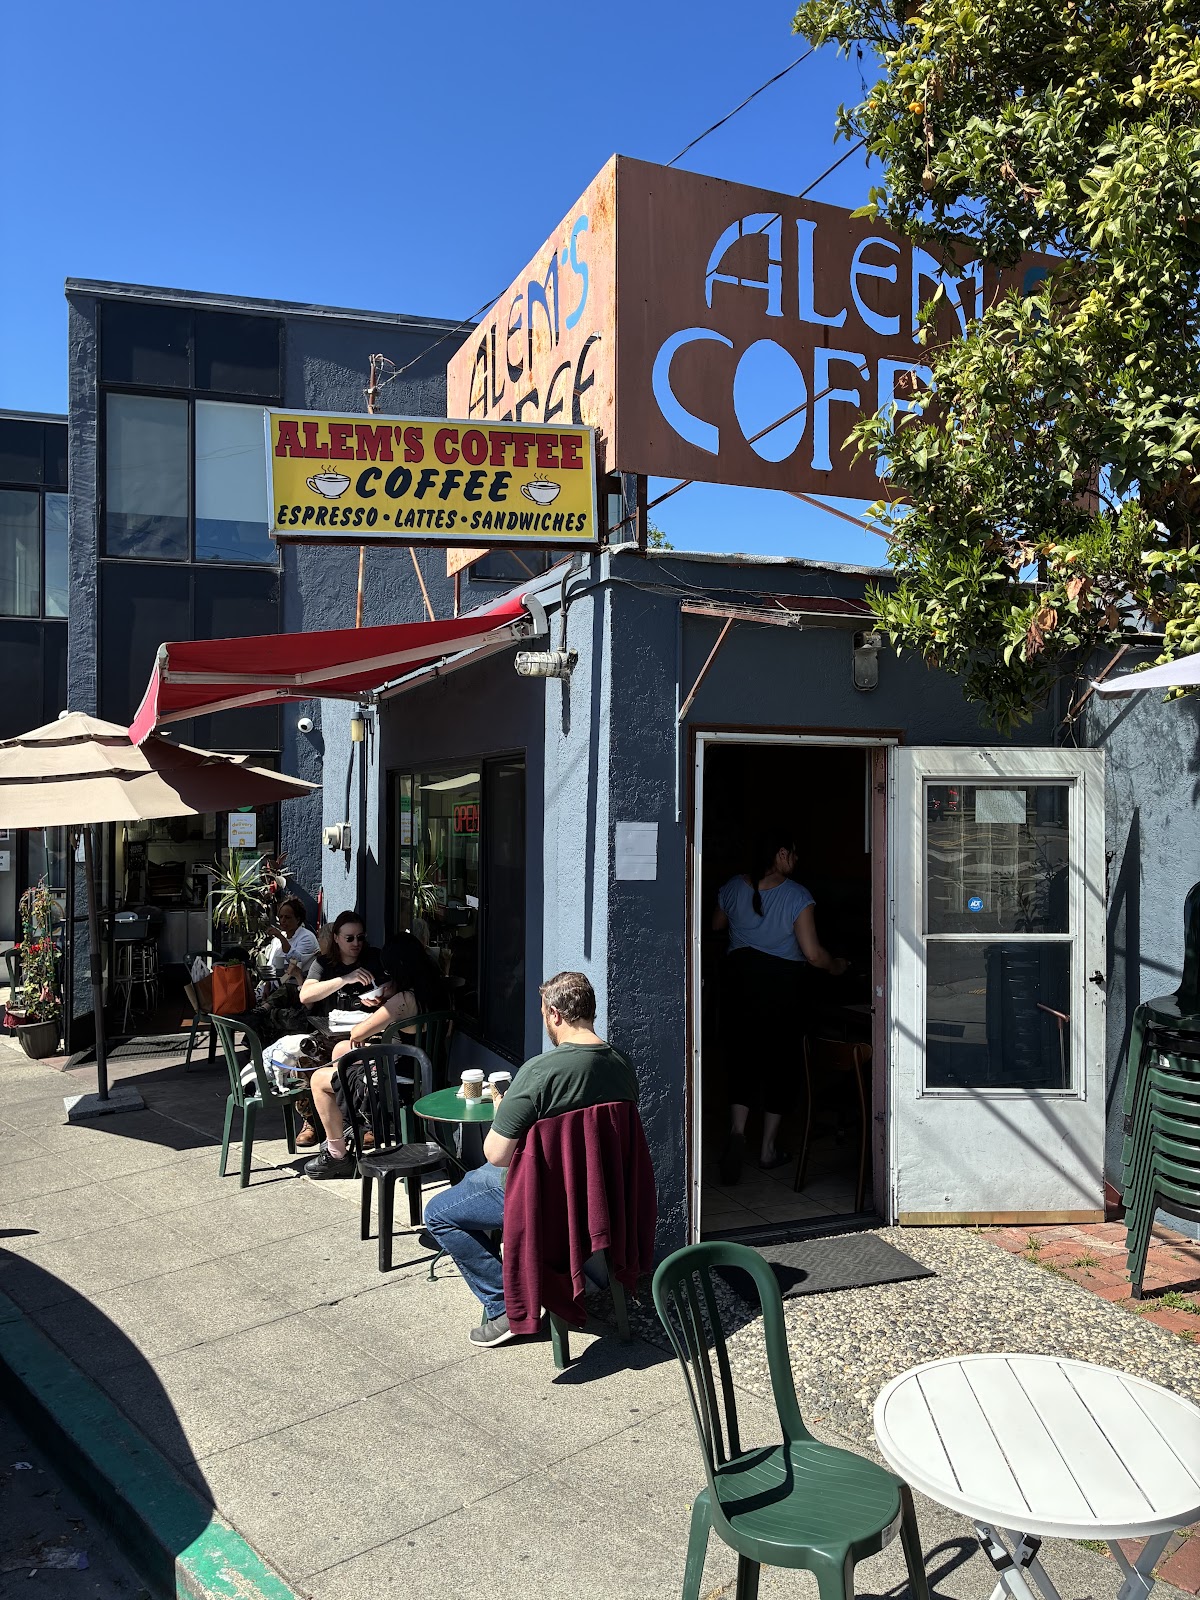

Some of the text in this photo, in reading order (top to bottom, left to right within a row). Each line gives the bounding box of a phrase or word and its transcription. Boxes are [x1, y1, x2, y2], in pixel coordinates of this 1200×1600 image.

[275, 420, 583, 470] ALEM'S COFFEE
[355, 465, 513, 502] COFFEE
[277, 504, 587, 533] ESPRESSO LATTES SANDWICHES
